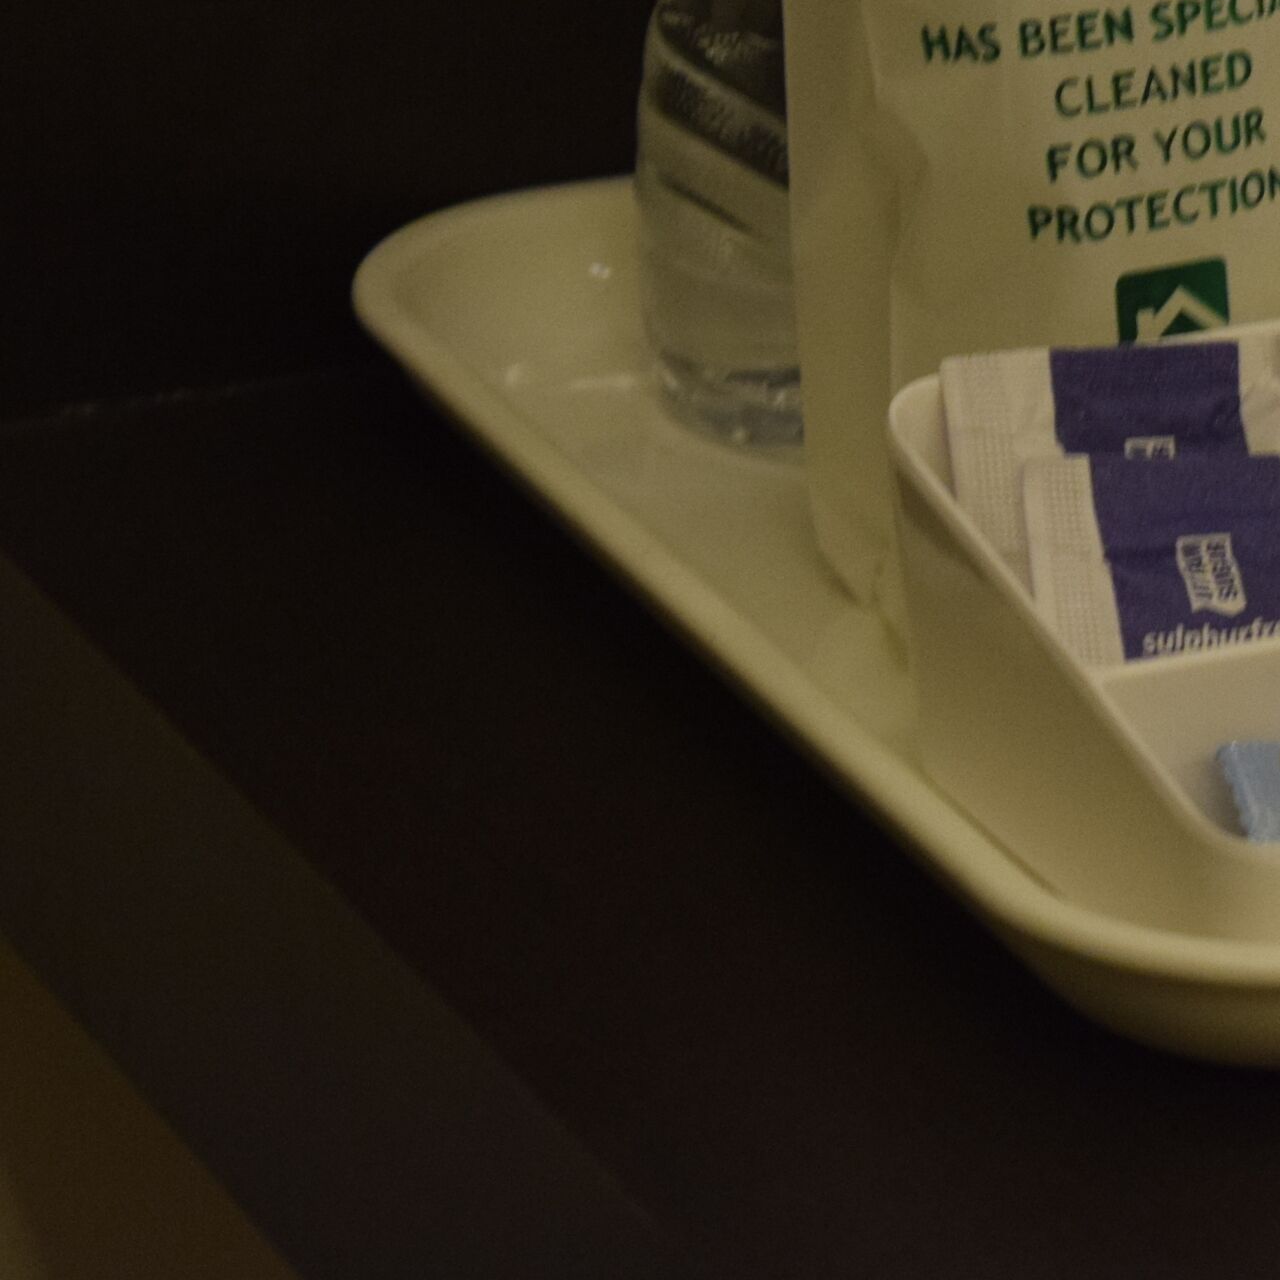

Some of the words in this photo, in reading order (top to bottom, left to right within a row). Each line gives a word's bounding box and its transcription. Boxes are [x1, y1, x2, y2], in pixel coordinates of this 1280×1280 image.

[920, 22, 1001, 64] HAS
[1017, 5, 1135, 59] BEEN
[1054, 49, 1254, 117] CLEANED
[1045, 135, 1138, 184] FOR
[1153, 107, 1268, 163] YOUR
